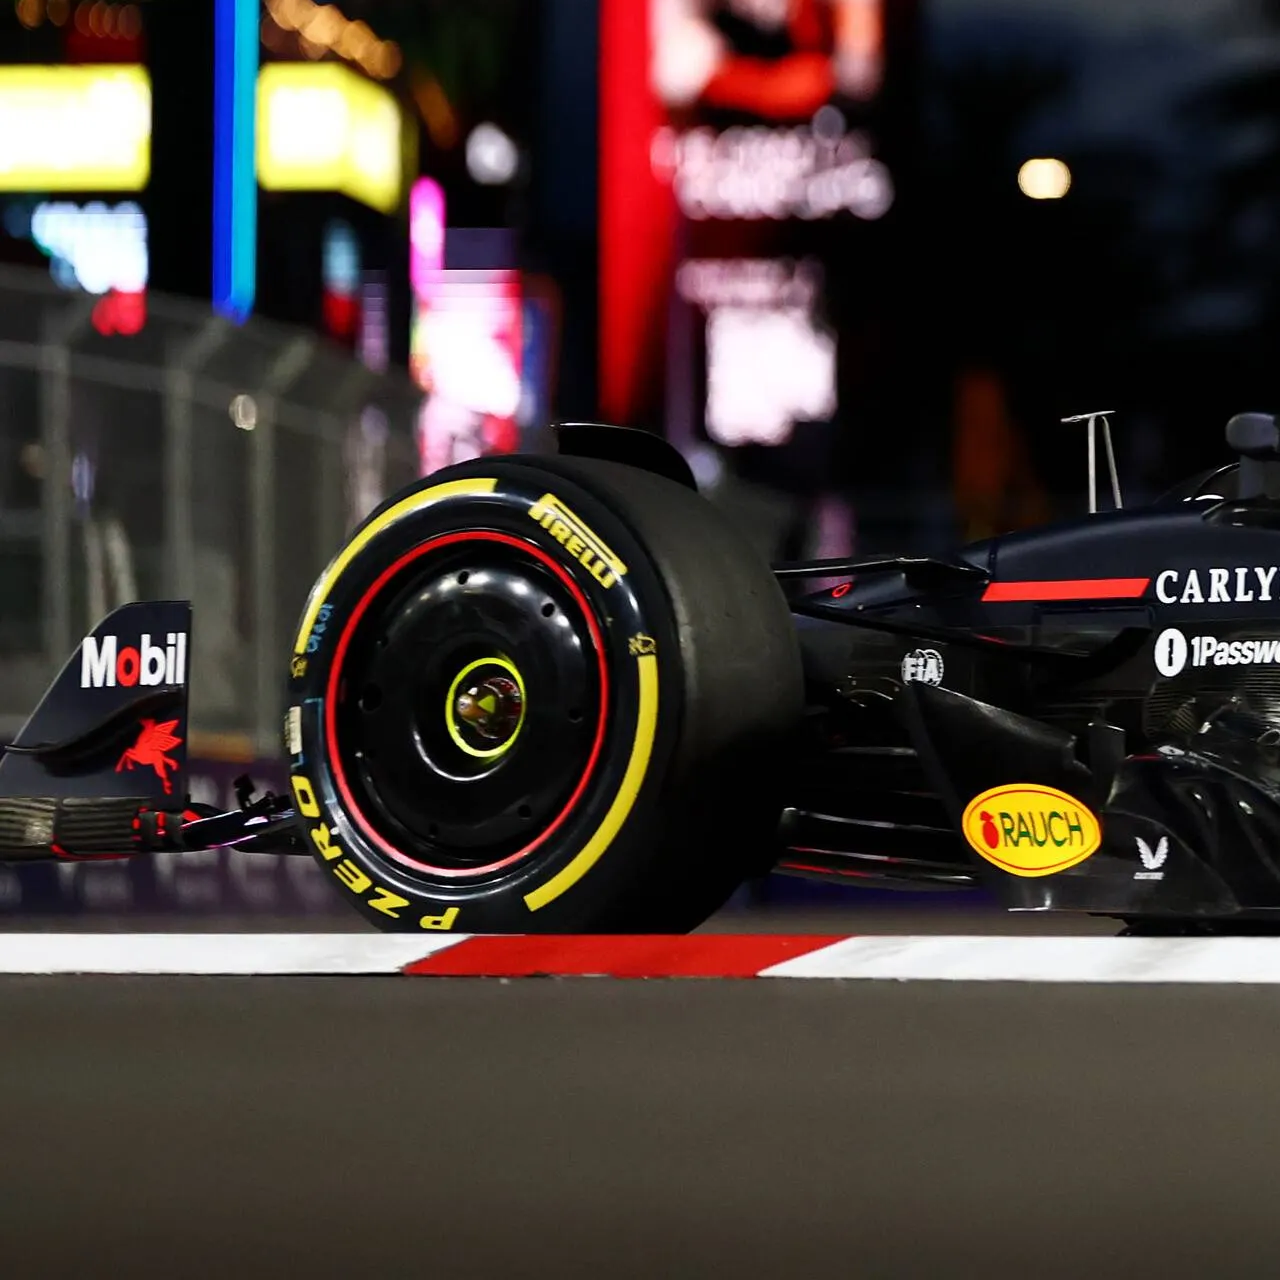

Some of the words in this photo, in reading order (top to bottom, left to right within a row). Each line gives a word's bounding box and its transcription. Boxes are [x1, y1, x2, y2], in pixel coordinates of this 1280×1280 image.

[527, 492, 628, 590] PIRELLI
[80, 632, 187, 688] Mobil
[998, 811, 1084, 847] RAUCH
